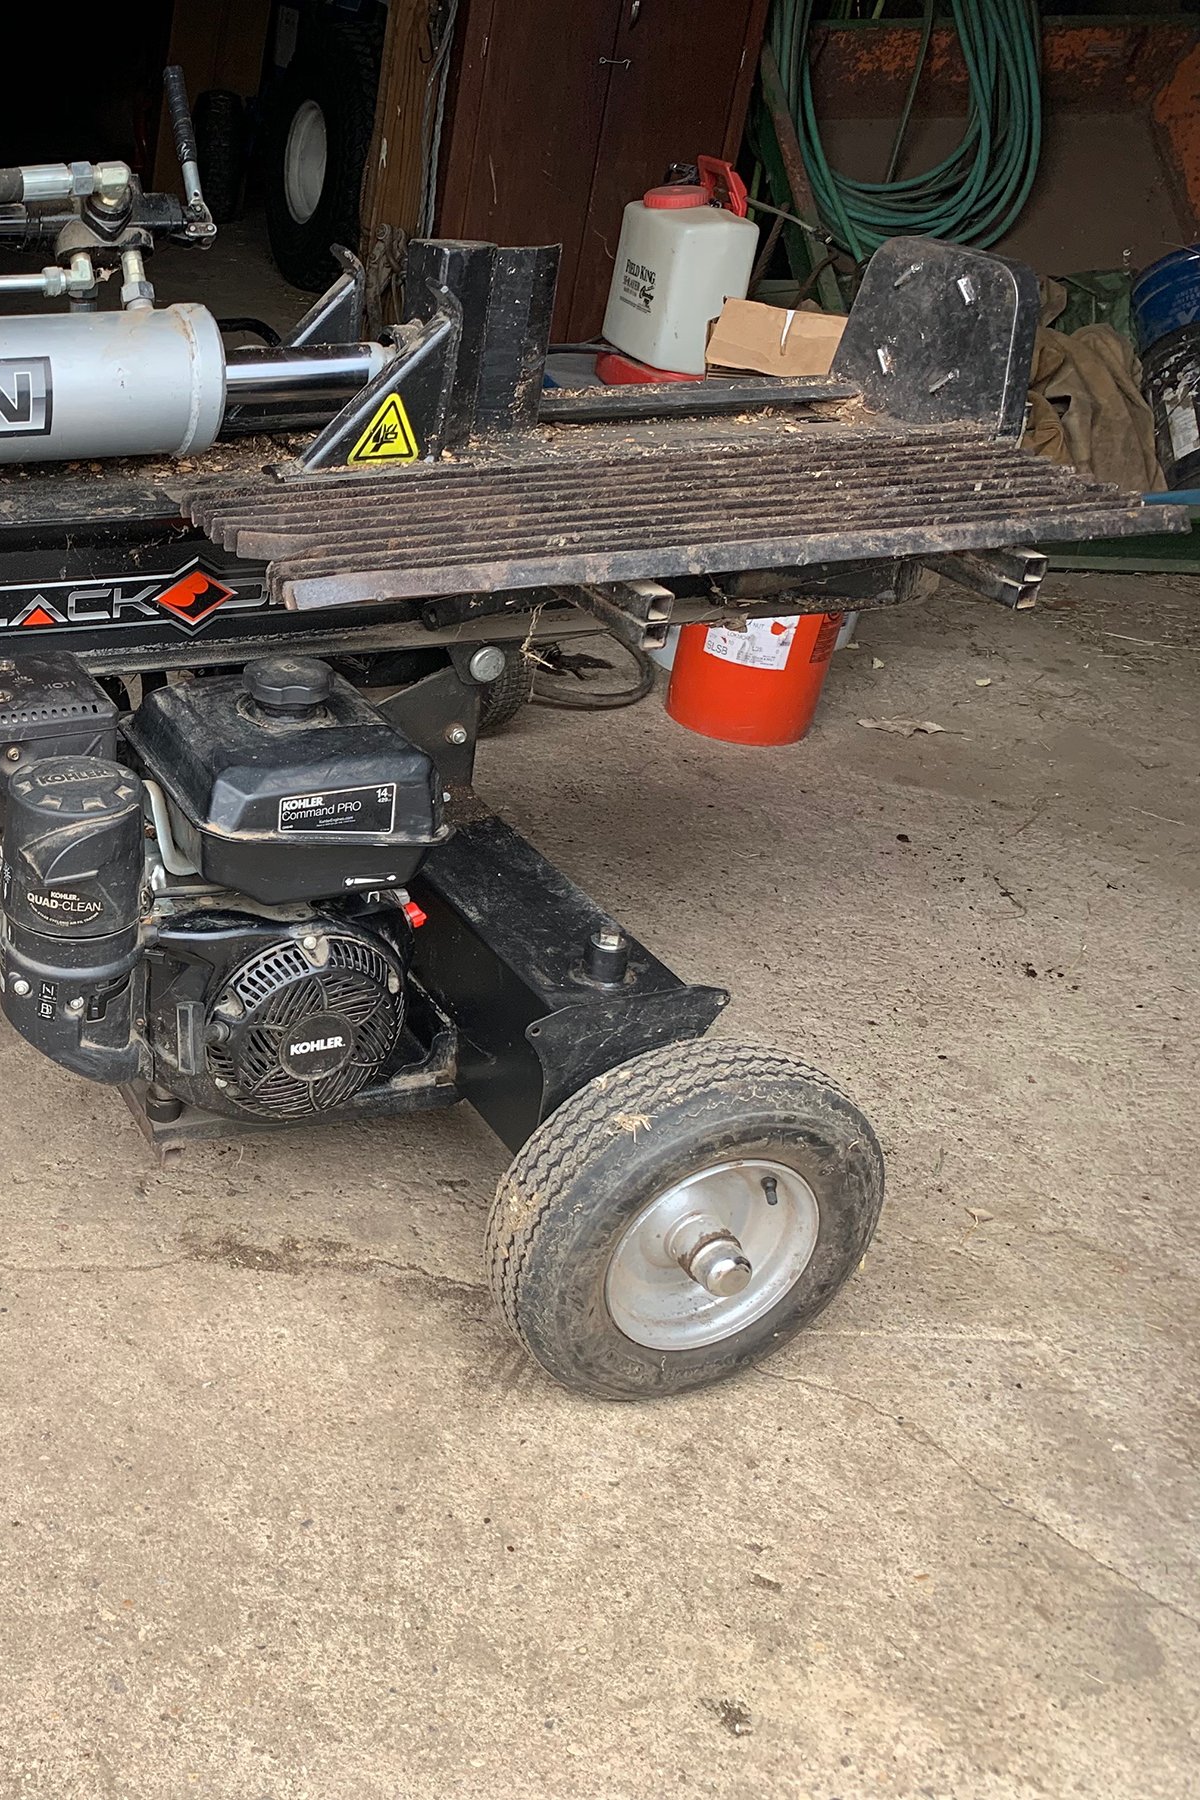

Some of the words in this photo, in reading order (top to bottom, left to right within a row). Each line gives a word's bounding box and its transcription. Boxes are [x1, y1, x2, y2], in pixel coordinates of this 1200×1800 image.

[640, 265, 656, 284] KING
[36, 769, 116, 787] KOHLER
[375, 788, 388, 799] 14
[281, 804, 335, 822] Command
[337, 800, 362, 814] PRO
[282, 796, 324, 812] KOHLER
[26, 892, 102, 912] QUAD-CLEAN
[50, 891, 78, 901] KOHLER
[289, 1035, 345, 1056] KOHLER
